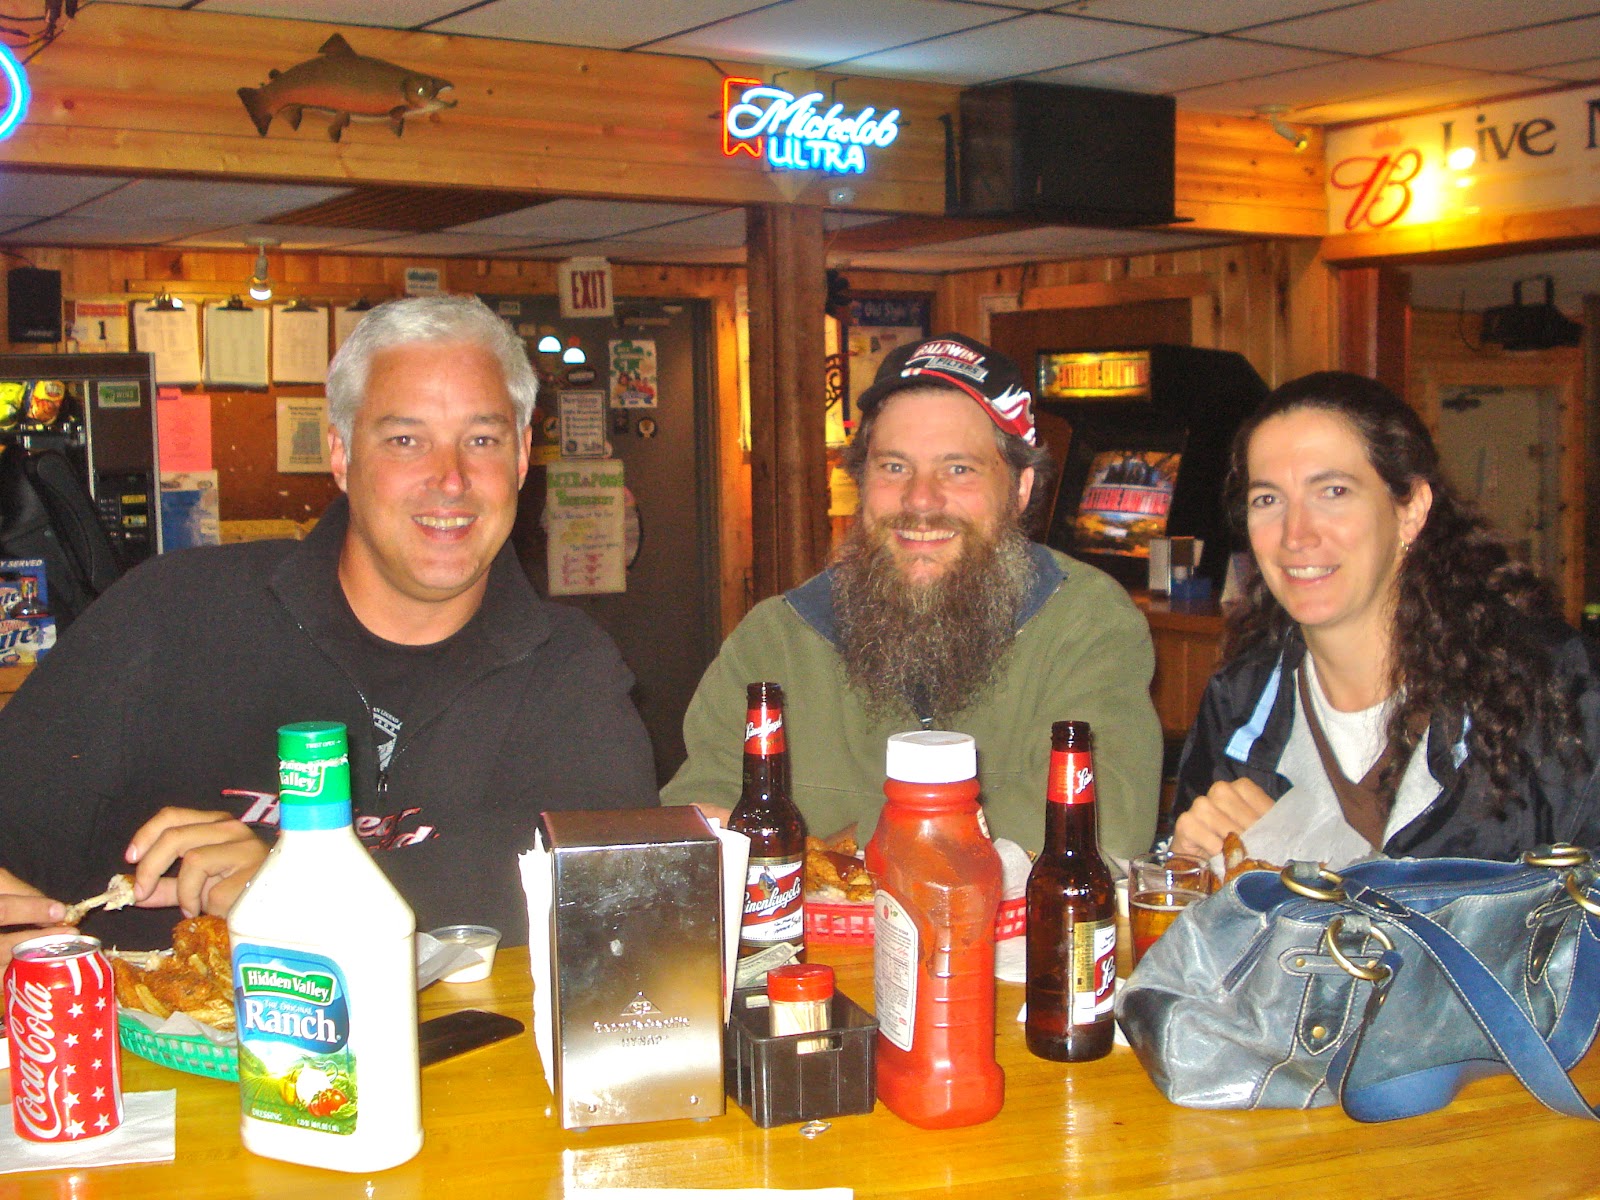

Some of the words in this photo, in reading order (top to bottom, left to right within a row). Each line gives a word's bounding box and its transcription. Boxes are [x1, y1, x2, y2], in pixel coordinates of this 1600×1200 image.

[727, 86, 900, 148] Michelob
[767, 136, 867, 174] ULTRA
[570, 270, 606, 309] EXIT
[913, 342, 978, 362] BALDWIN
[936, 357, 980, 375] FILTERS
[248, 969, 291, 991] Hidden
[292, 976, 331, 1003] Valley
[244, 998, 338, 1044] Ranch
